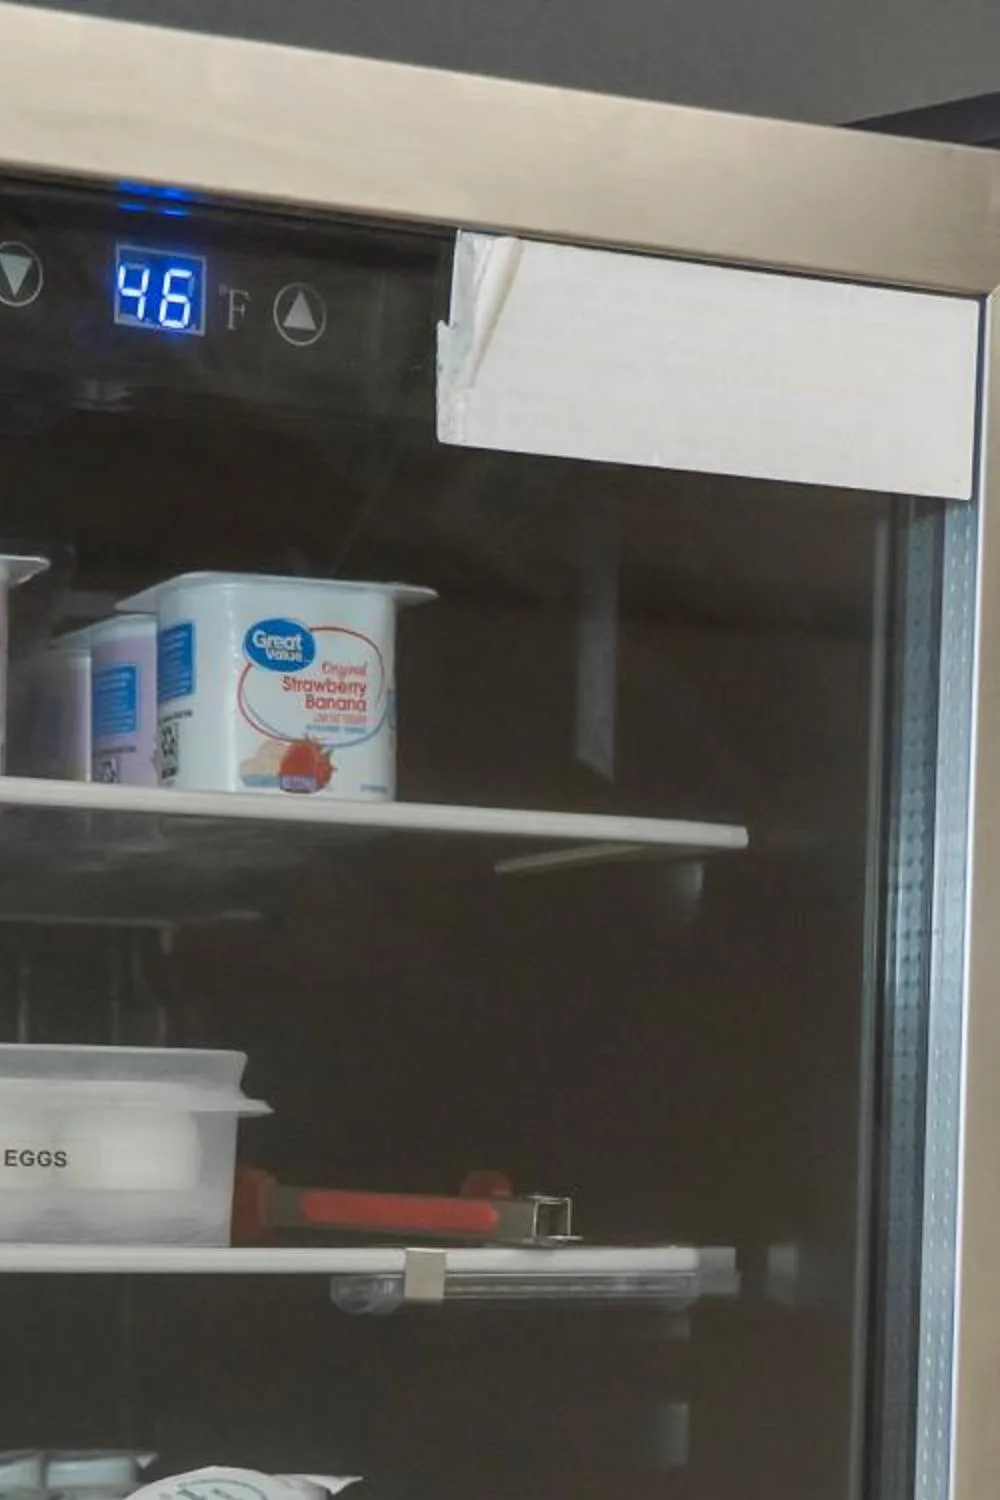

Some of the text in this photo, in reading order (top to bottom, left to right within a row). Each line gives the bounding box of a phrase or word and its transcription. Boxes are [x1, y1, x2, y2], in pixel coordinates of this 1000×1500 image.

[117, 262, 193, 328] 46
[252, 631, 303, 650] Great
[266, 648, 303, 663] Value
[282, 676, 367, 698] Strawberry
[305, 695, 367, 711] Banana
[3, 1150, 68, 1168] EGGS
